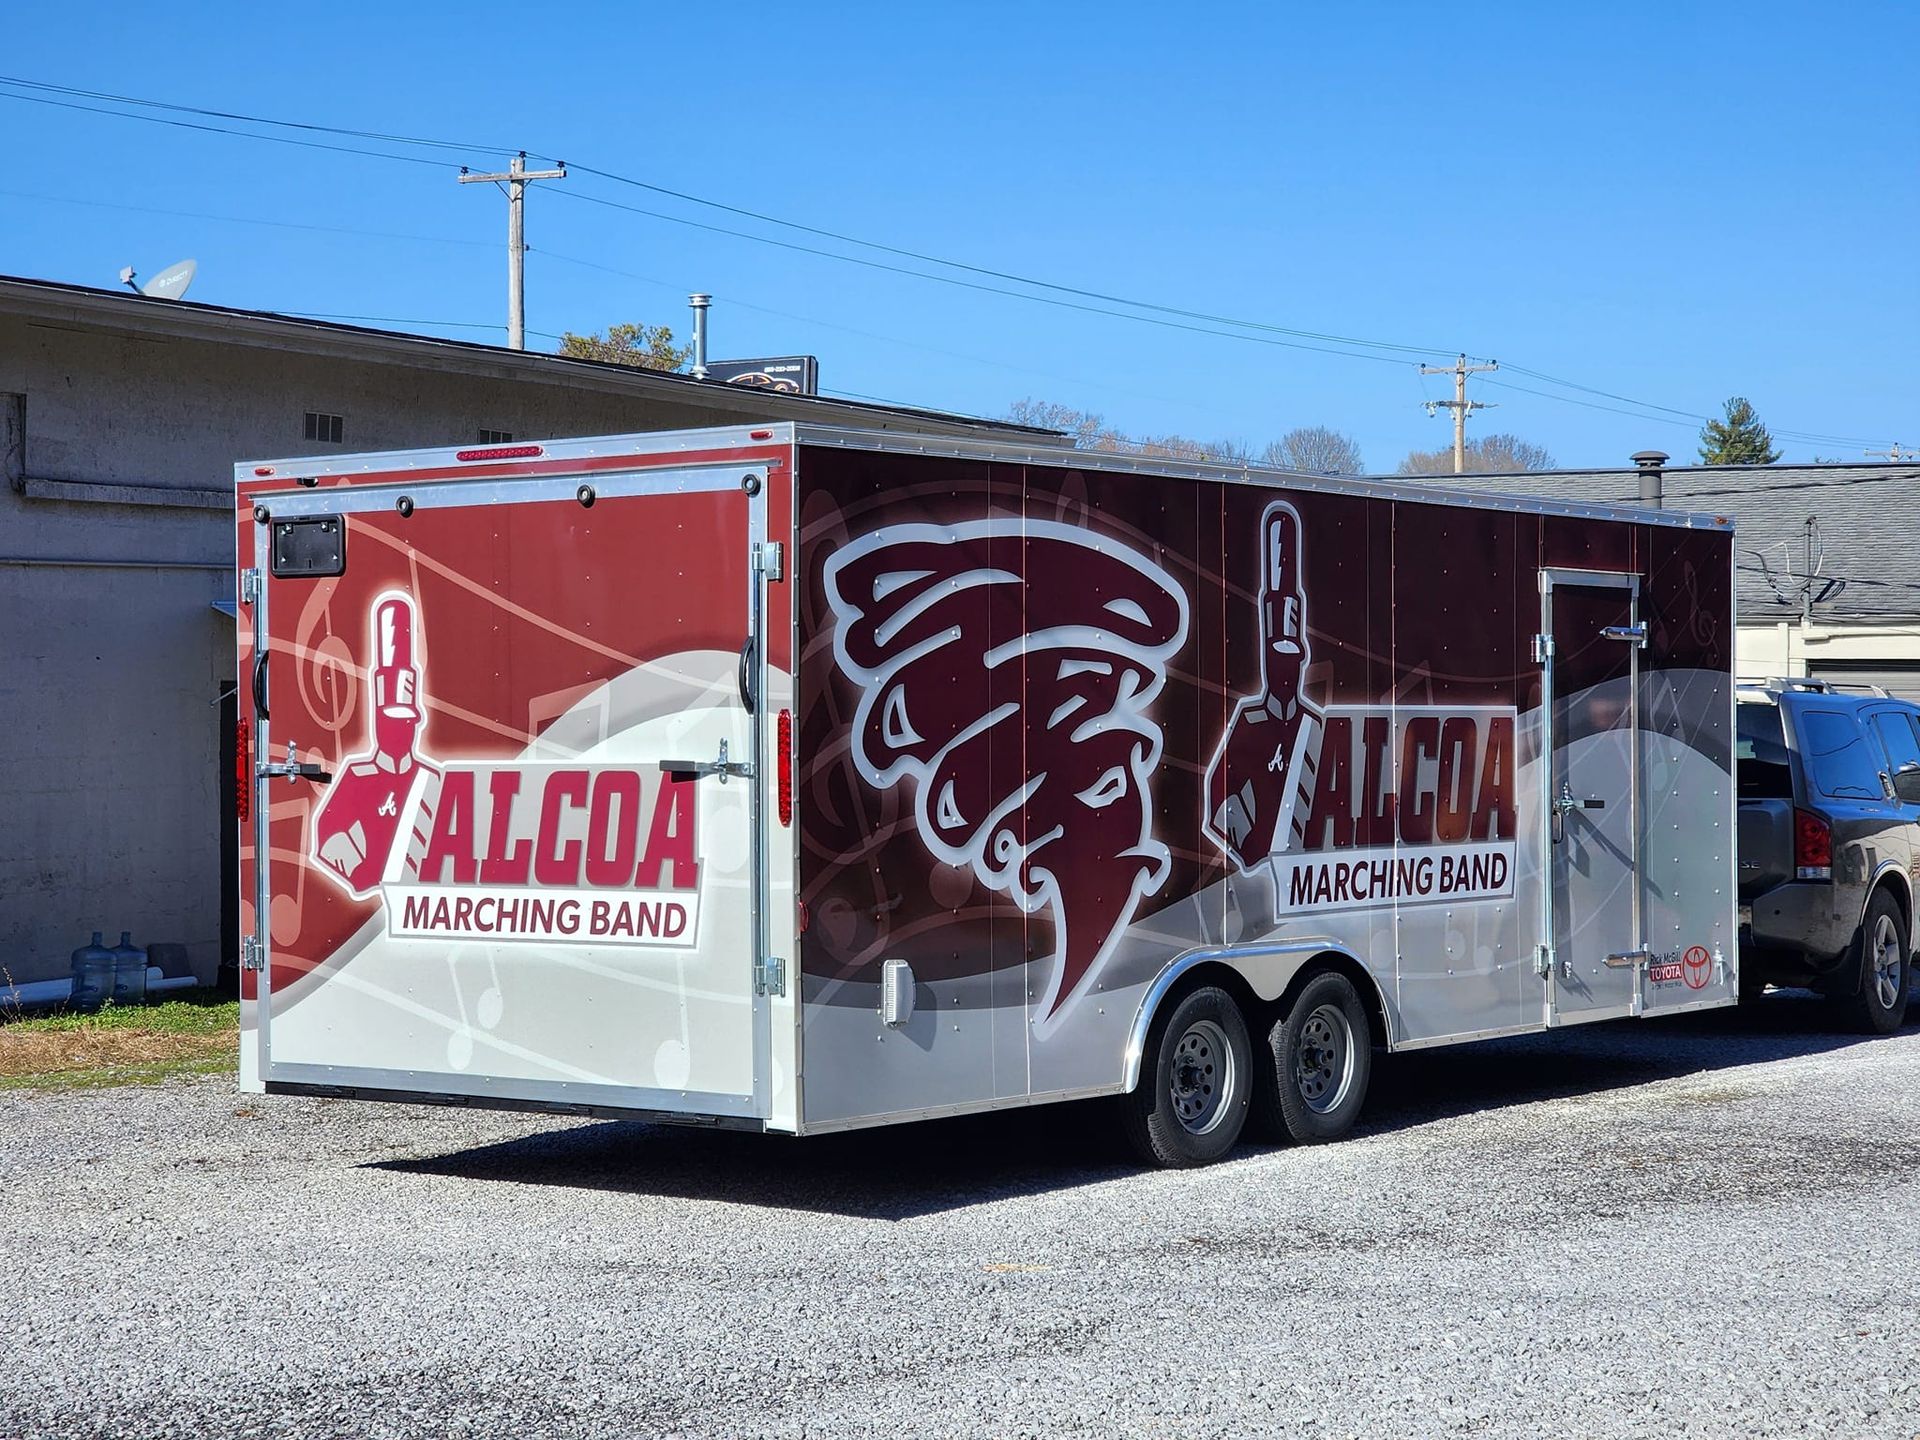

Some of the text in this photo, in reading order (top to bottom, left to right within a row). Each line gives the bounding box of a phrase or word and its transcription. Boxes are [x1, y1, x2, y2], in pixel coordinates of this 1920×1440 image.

[1268, 744, 1283, 772] A
[378, 792, 396, 816] A
[1303, 717, 1517, 849] ALCOA
[419, 771, 699, 888] ALCOA
[1290, 853, 1507, 906] MARCHING BAND
[403, 896, 687, 938] MARCHING BAND
[1651, 965, 1681, 980] TOYOTA
